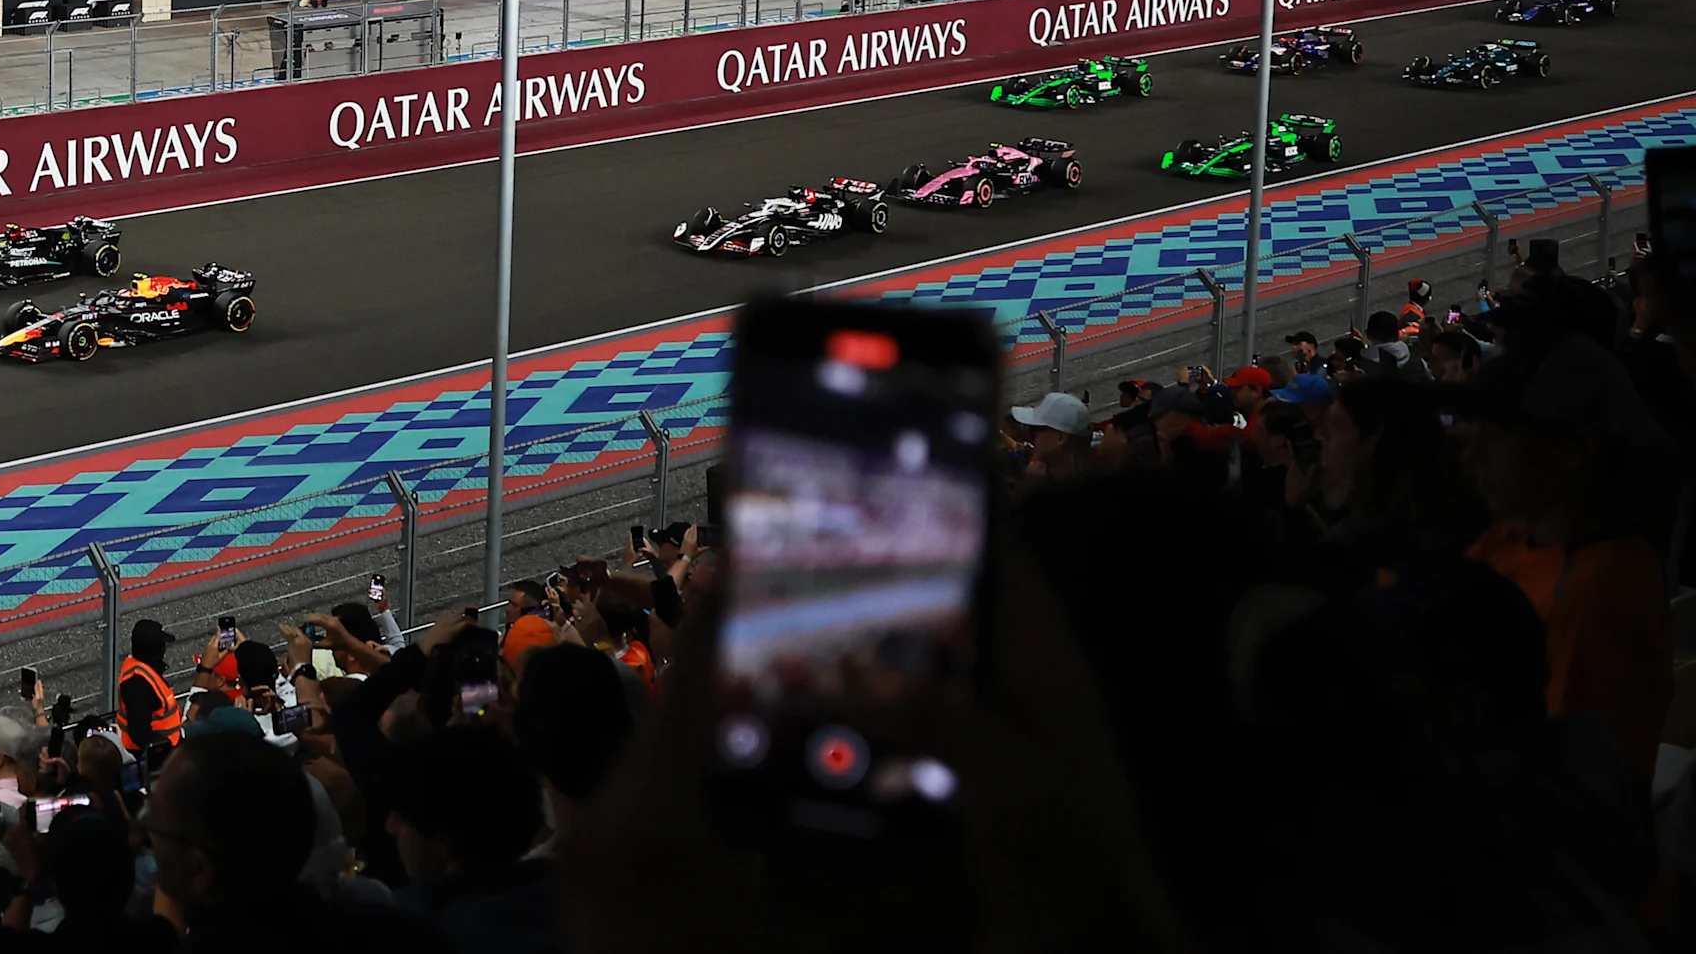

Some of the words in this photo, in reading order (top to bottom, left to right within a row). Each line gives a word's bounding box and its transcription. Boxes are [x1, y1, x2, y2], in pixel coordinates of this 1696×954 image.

[1028, 0, 1118, 47] QATAR
[716, 38, 828, 93] QATAR
[836, 18, 968, 74] AIRWAYS
[328, 86, 471, 150] QATAR
[483, 62, 646, 127] AIRWAYS
[29, 117, 238, 192] AIRWAYS
[10, 257, 47, 267] PETRONAS
[130, 309, 180, 323] ORACLE
